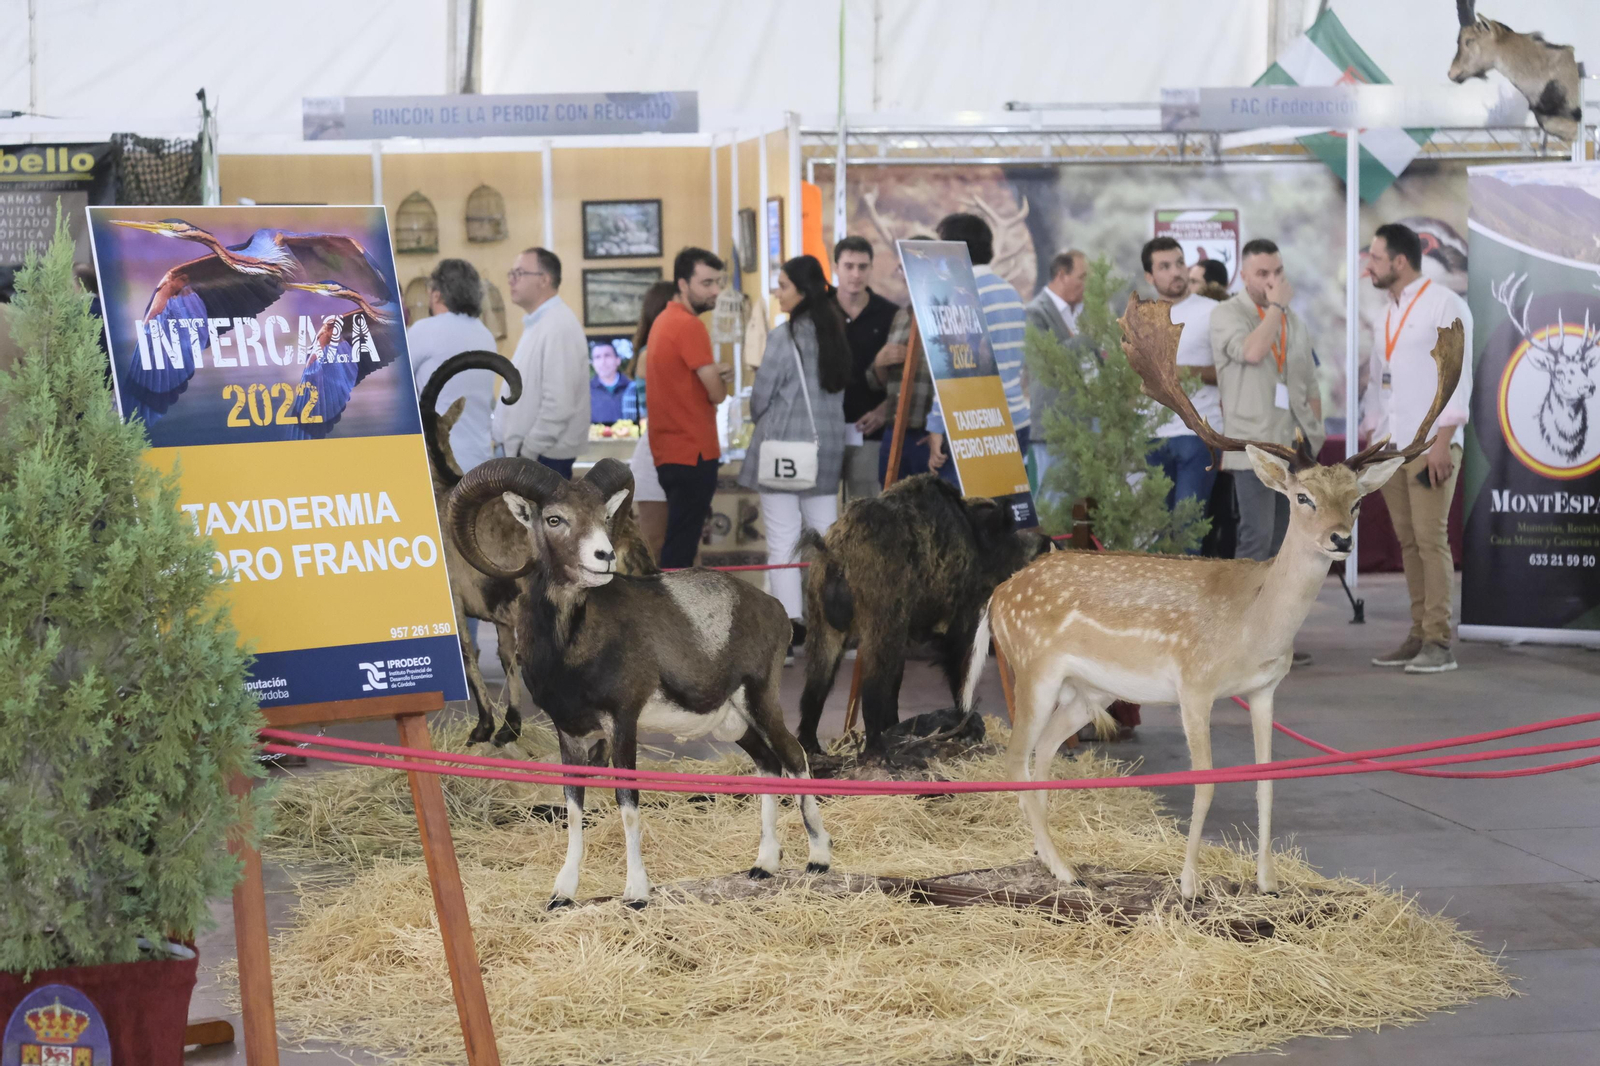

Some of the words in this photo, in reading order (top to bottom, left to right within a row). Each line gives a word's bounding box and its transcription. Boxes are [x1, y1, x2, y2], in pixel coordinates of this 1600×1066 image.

[372, 104, 434, 125] RINCÓN
[440, 107, 460, 124] DE
[466, 106, 486, 123] LA
[492, 104, 549, 122] PERDIZ
[555, 103, 588, 121] CON
[1230, 98, 1260, 114] FAC
[134, 313, 381, 371] INTERCAZA
[222, 382, 324, 428] 2022
[953, 407, 1005, 431] TAXIDERMIA
[952, 436, 985, 460] PEDRO
[982, 433, 1019, 456] FRANCO
[181, 491, 401, 537] TAXIDERMIA
[291, 534, 438, 578] FRANCO
[1529, 553, 1548, 566] 633
[1550, 554, 1563, 566] 21
[390, 626, 409, 639] 957
[411, 624, 430, 637] 261
[432, 622, 451, 635] 350
[386, 656, 432, 669] IPRODECO
